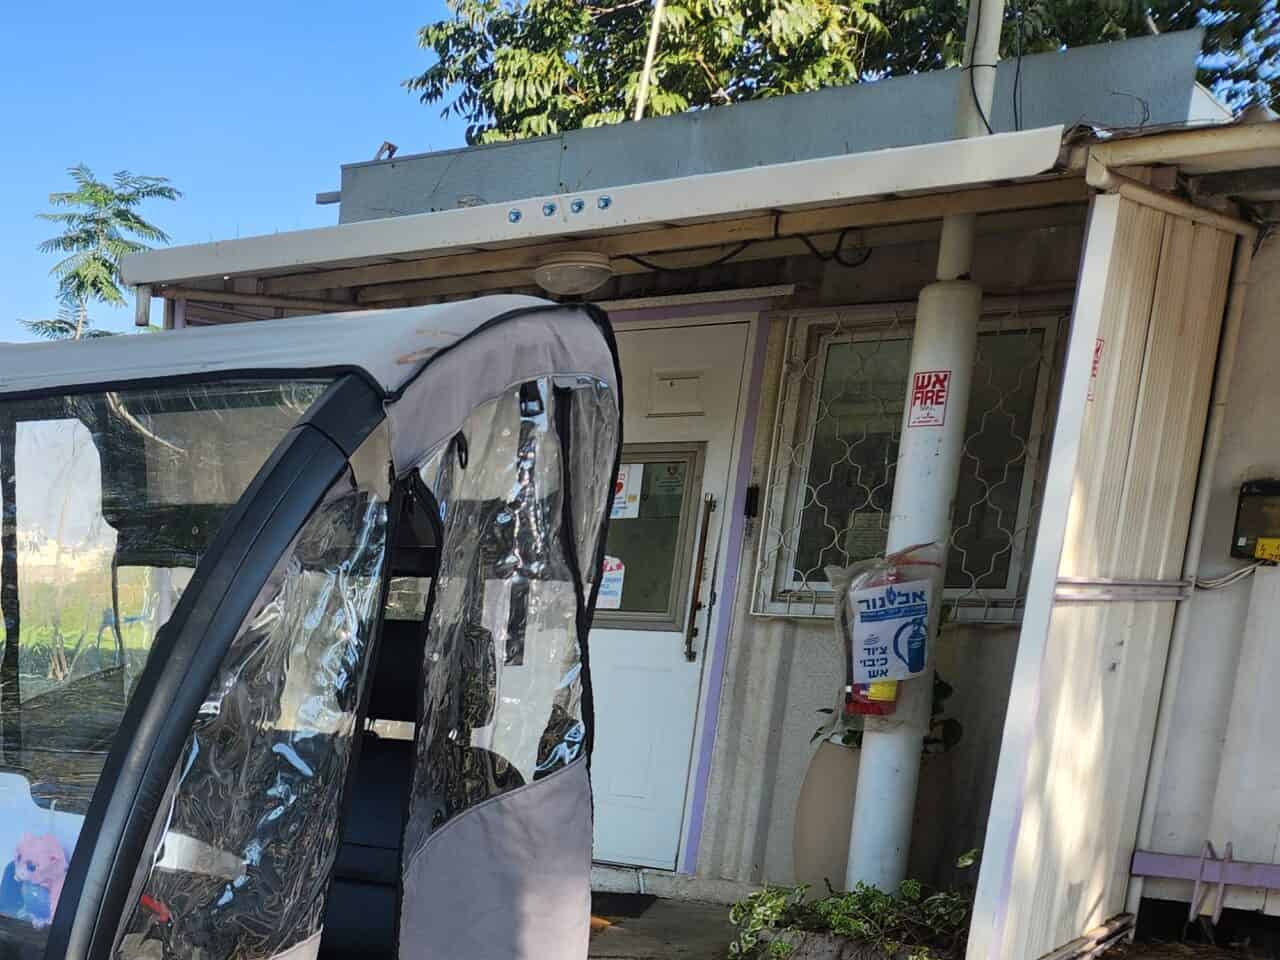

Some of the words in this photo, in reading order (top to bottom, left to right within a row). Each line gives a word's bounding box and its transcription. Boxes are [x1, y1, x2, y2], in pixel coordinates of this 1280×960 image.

[915, 373, 948, 390] אש
[912, 390, 946, 406] FIRE
[863, 646, 888, 656] ציוד
[859, 657, 888, 668] כיבוי
[867, 668, 889, 679] אש
